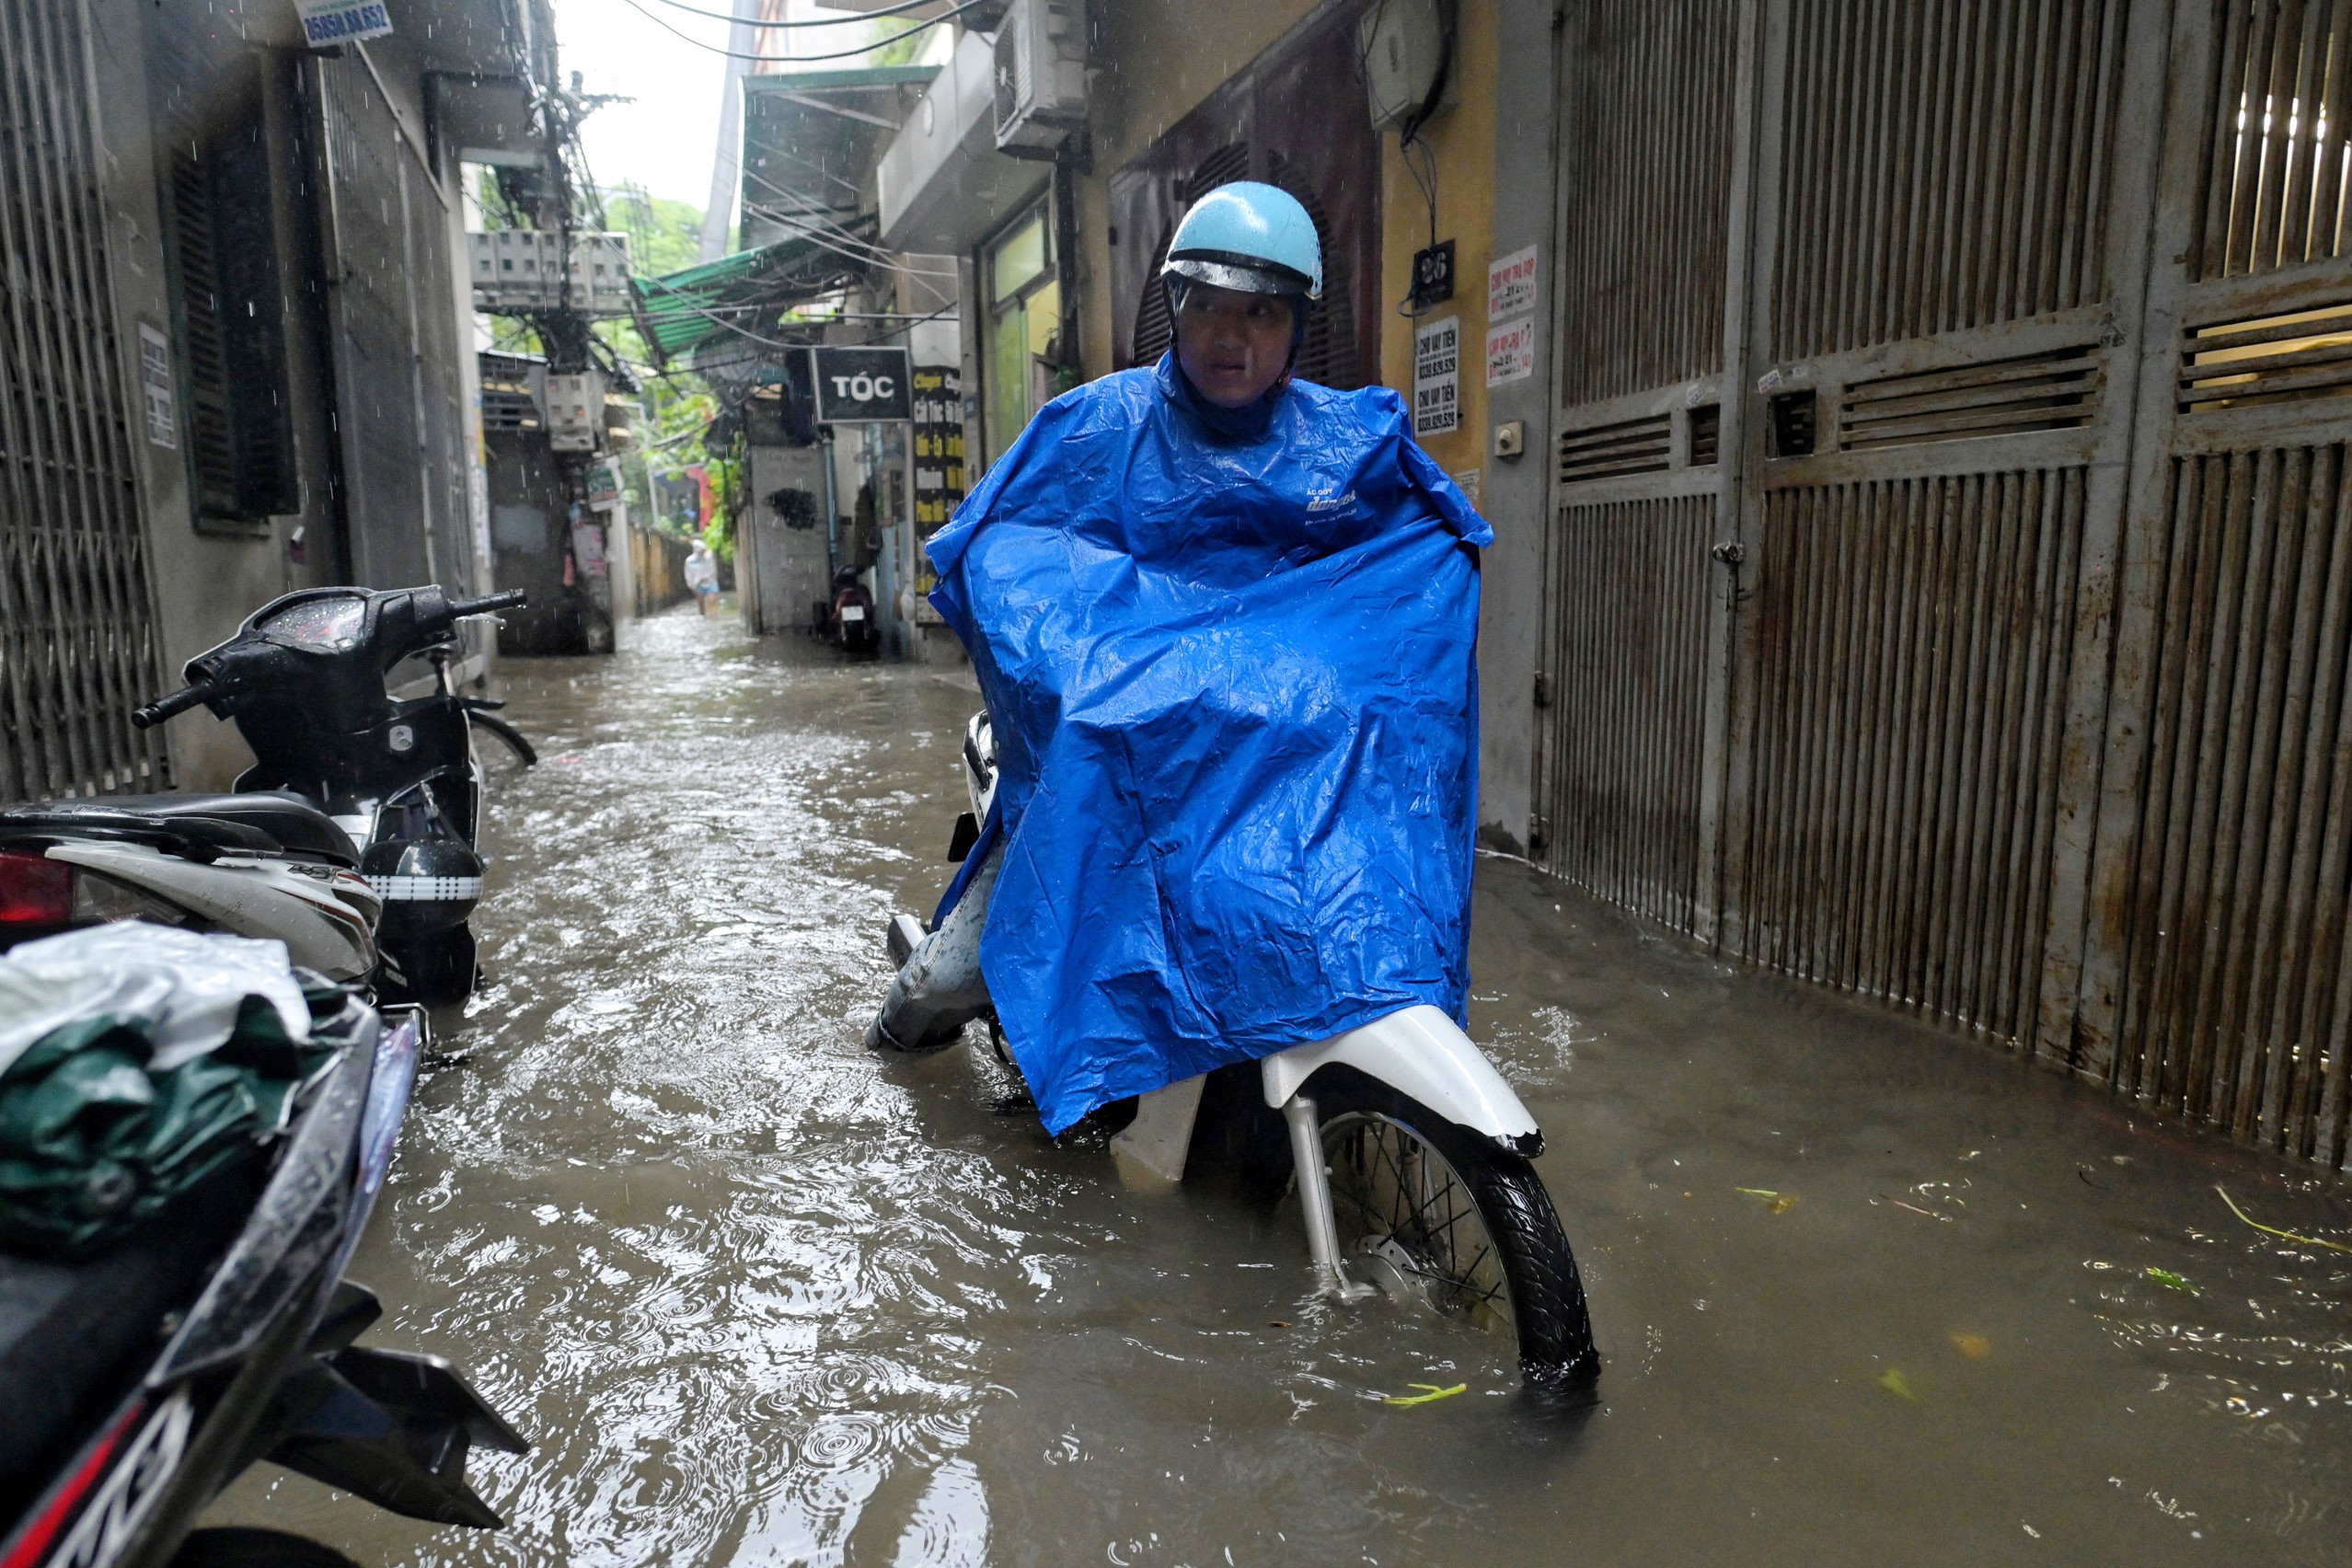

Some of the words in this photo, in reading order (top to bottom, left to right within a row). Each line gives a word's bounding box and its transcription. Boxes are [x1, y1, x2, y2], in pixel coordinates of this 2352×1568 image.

[1422, 251, 1447, 283] 26
[1419, 337, 1430, 356] CHO
[1431, 333, 1441, 352] VAY
[831, 371, 894, 402] TÓC
[1418, 389, 1429, 408] CHO
[1430, 386, 1440, 405] VAY
